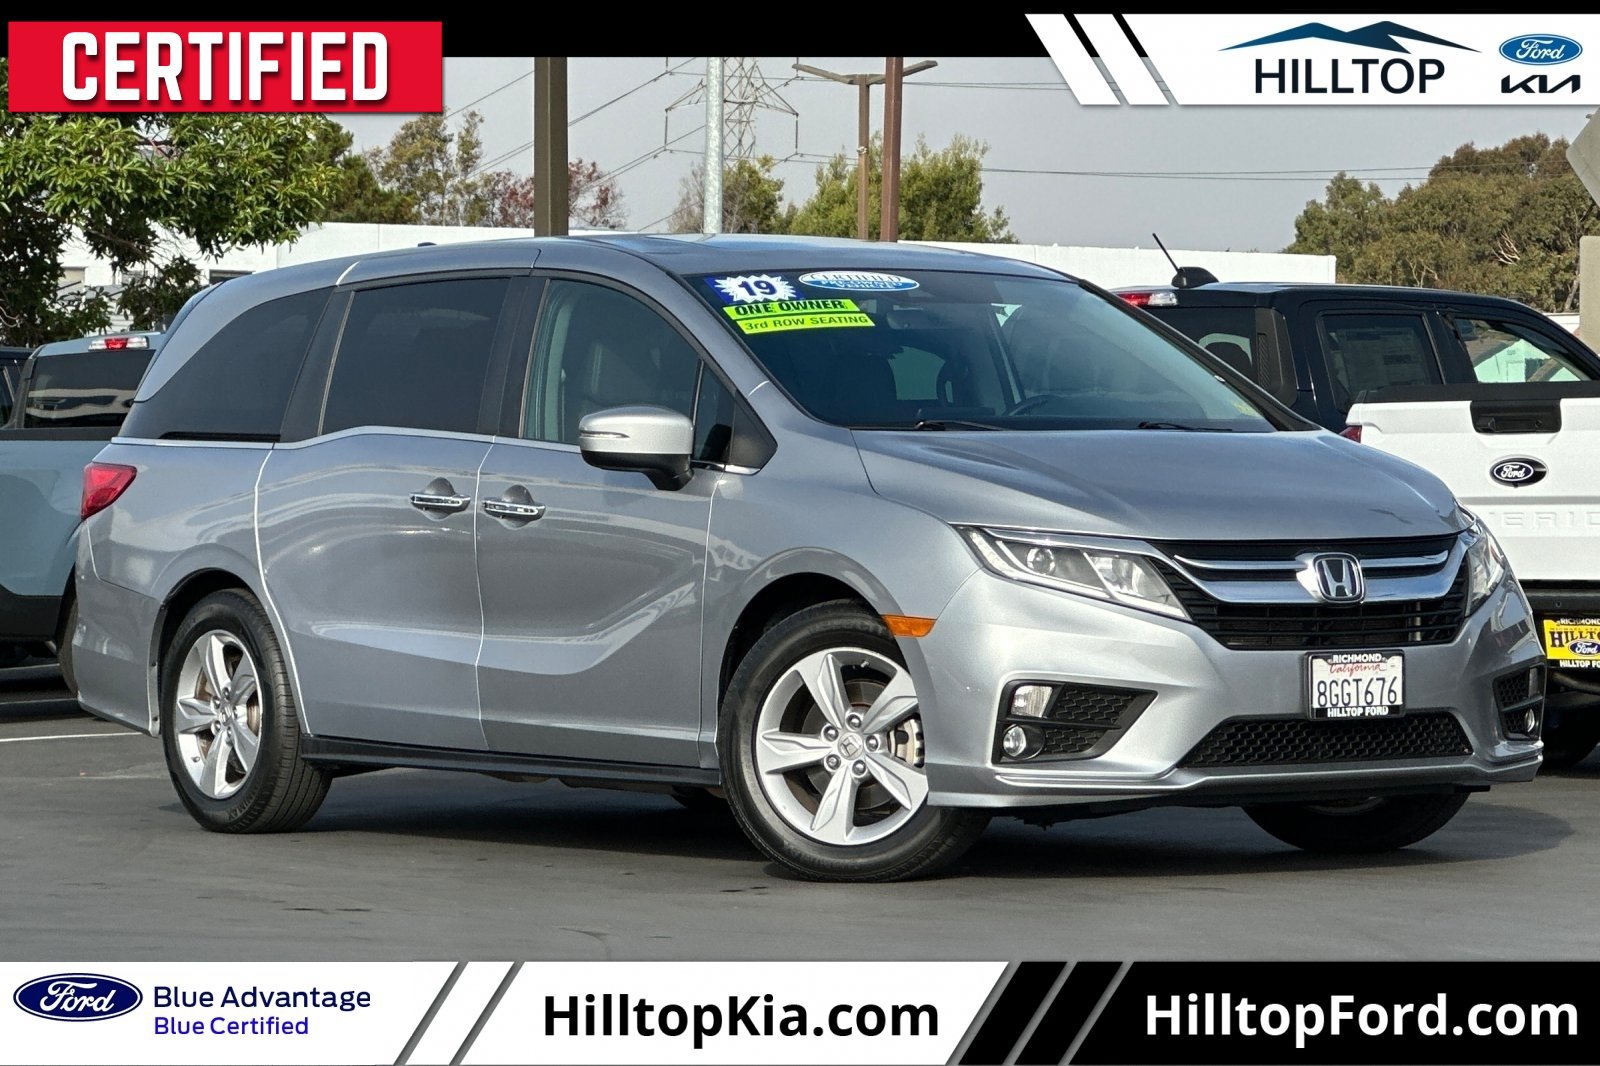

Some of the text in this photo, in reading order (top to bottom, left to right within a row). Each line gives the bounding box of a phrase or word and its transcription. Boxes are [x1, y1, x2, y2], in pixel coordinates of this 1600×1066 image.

[738, 280, 777, 297] 19
[735, 300, 845, 316] ONE OWNER
[744, 315, 869, 331] 3rd ROW SEATING
[1501, 464, 1526, 478] Ford
[1575, 642, 1599, 654] Ford
[1332, 653, 1382, 663] RICHMOND
[1559, 659, 1591, 668] HILLTOP
[1329, 662, 1387, 677] California
[1317, 676, 1398, 707] 8GGT676
[1327, 706, 1389, 717] HILLTOP FORD
